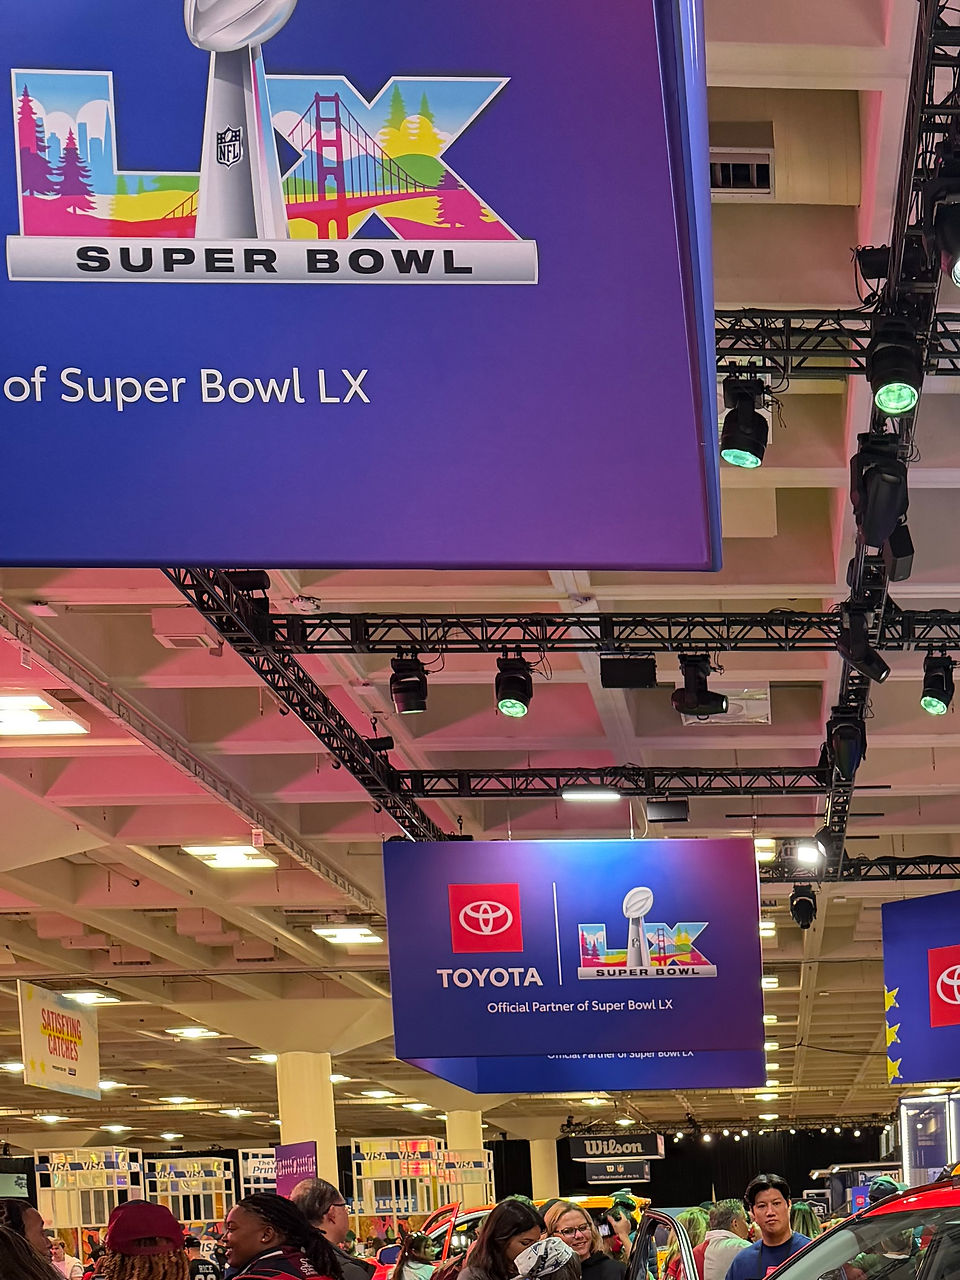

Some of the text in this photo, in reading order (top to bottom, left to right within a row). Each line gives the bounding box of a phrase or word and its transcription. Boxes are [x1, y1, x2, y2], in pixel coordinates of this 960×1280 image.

[218, 143, 240, 163] NFL
[76, 246, 473, 276] SUPER BOWL
[3, 366, 371, 412] of Super Bowl LX
[436, 967, 544, 988] TOYOTA
[596, 967, 700, 977] SUPER BOWL
[487, 999, 673, 1013] Official Partner of Super Bowl LX
[41, 1008, 82, 1040] SATISFYING
[48, 1033, 78, 1061] CATCHES
[584, 1139, 643, 1155] Wilson
[364, 1151, 388, 1160] VISA
[399, 1151, 421, 1160] VISA
[47, 1161, 105, 1172] VISA VISA
[454, 1161, 475, 1169] VISA
[156, 1170, 205, 1179] VISA VISA
[197, 1264, 214, 1273] RICE
